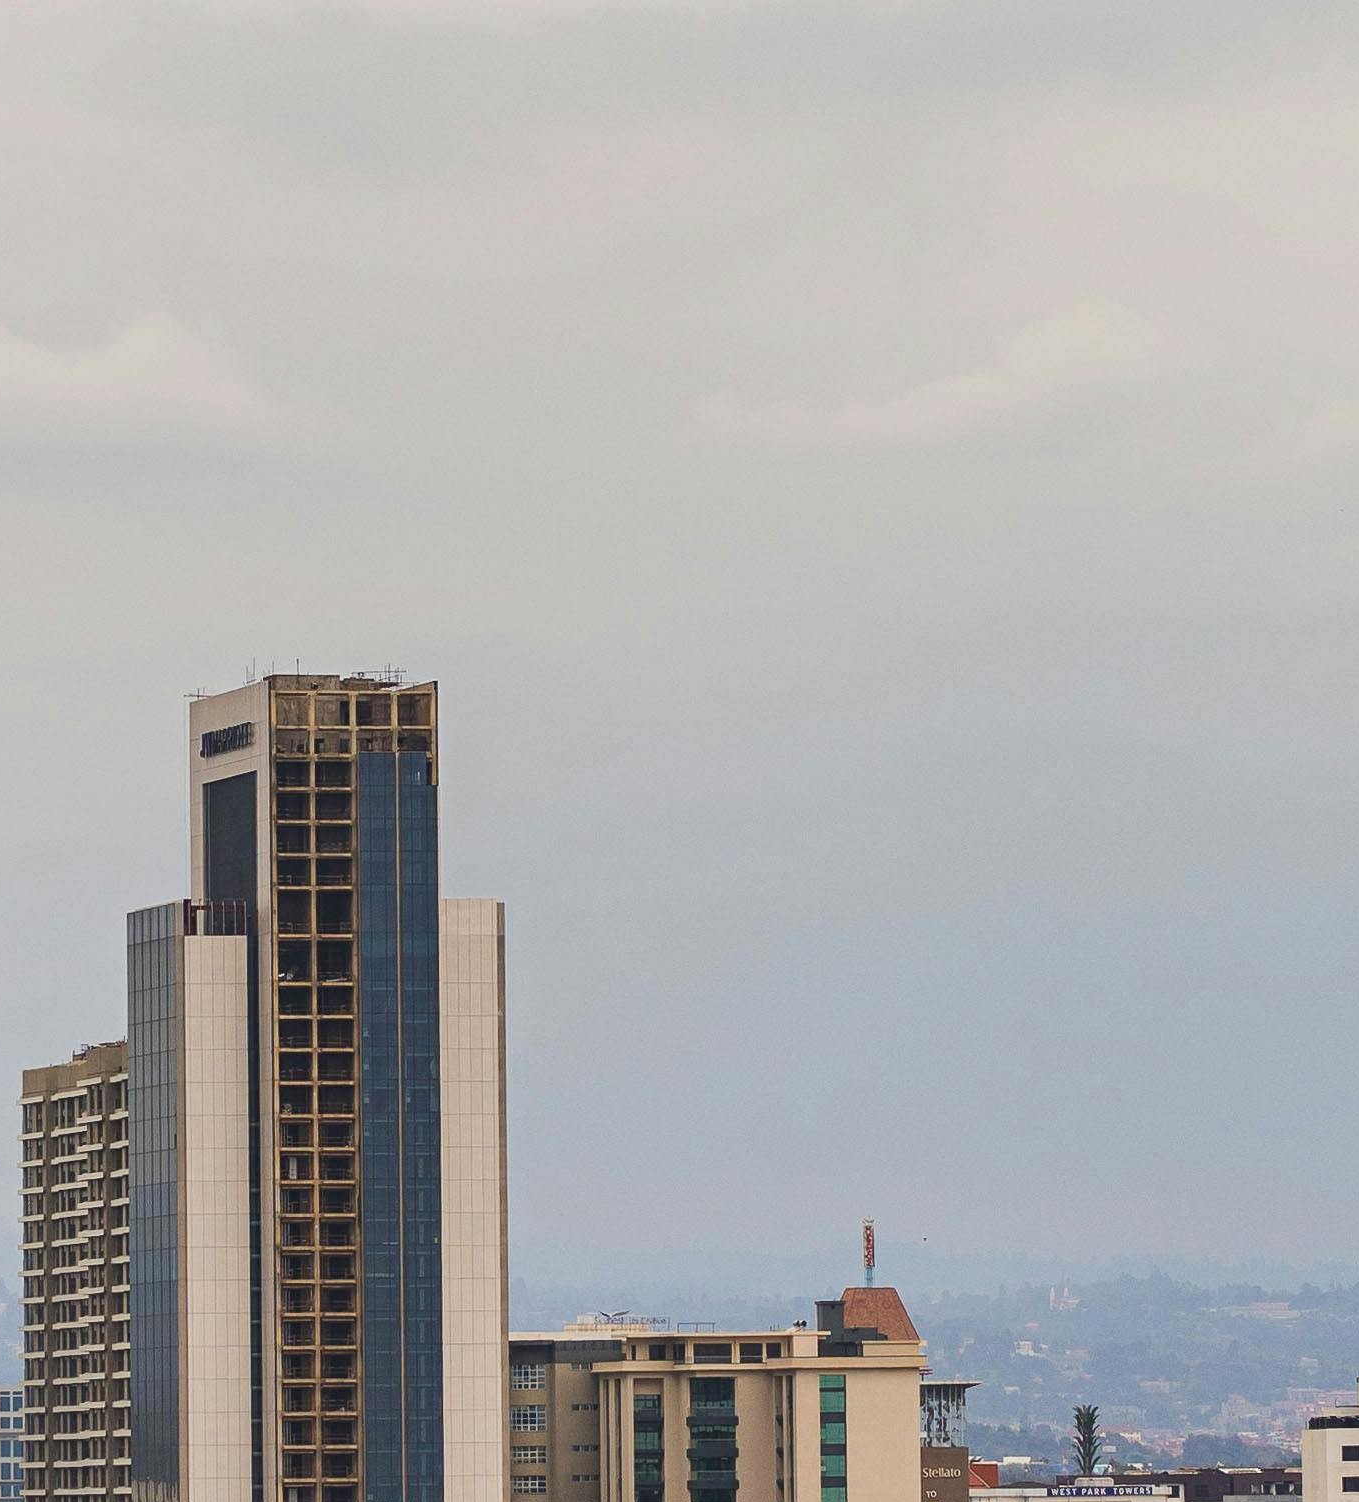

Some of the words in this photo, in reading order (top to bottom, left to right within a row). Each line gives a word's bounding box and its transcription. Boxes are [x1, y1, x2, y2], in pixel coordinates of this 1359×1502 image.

[922, 1467, 961, 1478] Stellato
[926, 1490, 937, 1498] TO
[1051, 1487, 1077, 1496] WEST
[1081, 1487, 1107, 1496] PARK
[1113, 1486, 1152, 1495] TOWERS
